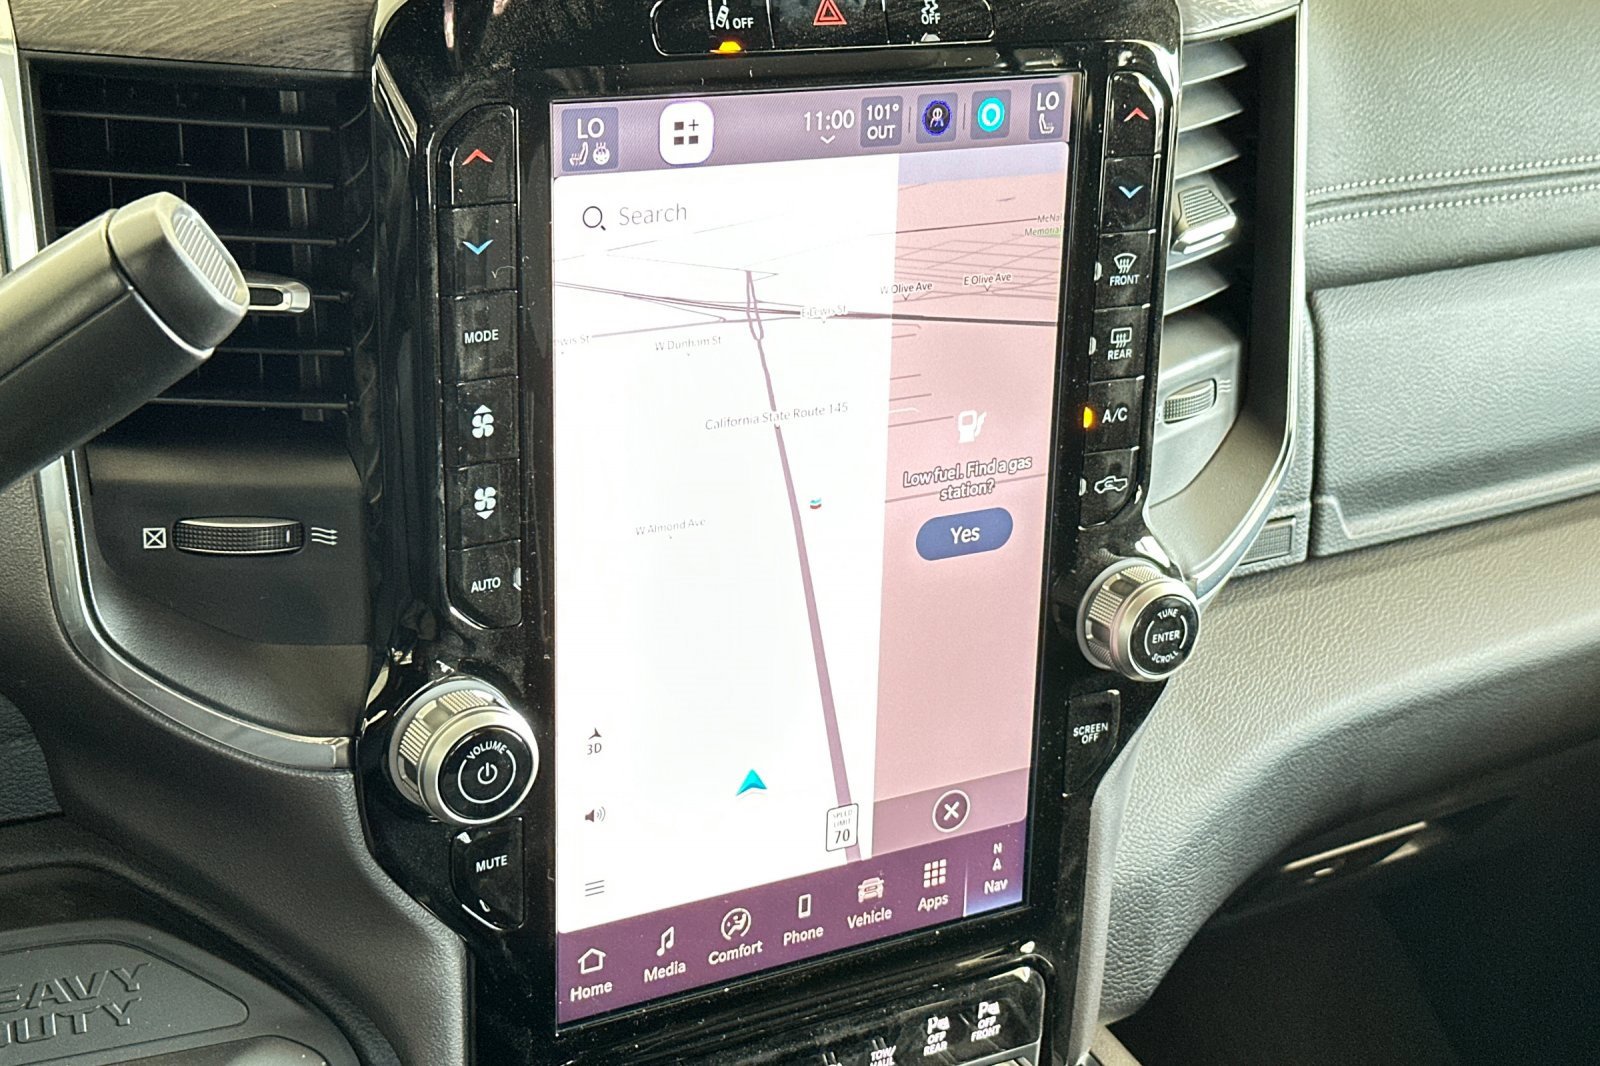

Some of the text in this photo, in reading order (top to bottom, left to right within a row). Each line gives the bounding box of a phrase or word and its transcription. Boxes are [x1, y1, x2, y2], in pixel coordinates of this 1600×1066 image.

[732, 17, 755, 29] OFF
[921, 14, 941, 25] OFF
[1036, 90, 1060, 112] LO
[803, 108, 855, 131] 11:00
[866, 103, 900, 121] 101°
[577, 117, 605, 139] LO
[867, 125, 896, 140] OUT
[618, 203, 688, 226] Search
[892, 283, 915, 294] Olive
[915, 281, 933, 292] Ave
[963, 272, 1012, 286] E Olive Ave
[1109, 274, 1141, 287] FRONT
[464, 328, 500, 344] MODE
[1107, 348, 1133, 361] REAR
[705, 402, 849, 430] California State Route 145
[1101, 407, 1128, 424] A/C
[903, 456, 1033, 488] Low fuel. Find a gas
[939, 478, 996, 502] station?
[950, 525, 981, 545] Yes
[470, 576, 501, 593] AUTO
[1157, 608, 1179, 620] TUNE
[1151, 628, 1181, 645] ENTER
[1151, 650, 1180, 664] SCROLL
[1073, 722, 1109, 737] SCREEN
[1080, 732, 1100, 745] OFF
[466, 740, 509, 761] VOLUME
[586, 742, 603, 756] 3D
[834, 828, 851, 844] 70
[475, 854, 509, 873] MUTE
[984, 878, 1009, 895] Nav
[917, 894, 950, 912] Apps
[847, 906, 893, 929] Vehicle
[783, 925, 824, 947] Phone
[708, 940, 764, 965] Comfort
[644, 960, 687, 983] Media
[570, 980, 613, 1002] Home
[0, 997, 142, 1049] UTY
[977, 1015, 997, 1030] OFF
[927, 1030, 947, 1045] OFF
[970, 1024, 1001, 1042] FRONT
[923, 1041, 948, 1057] REAR
